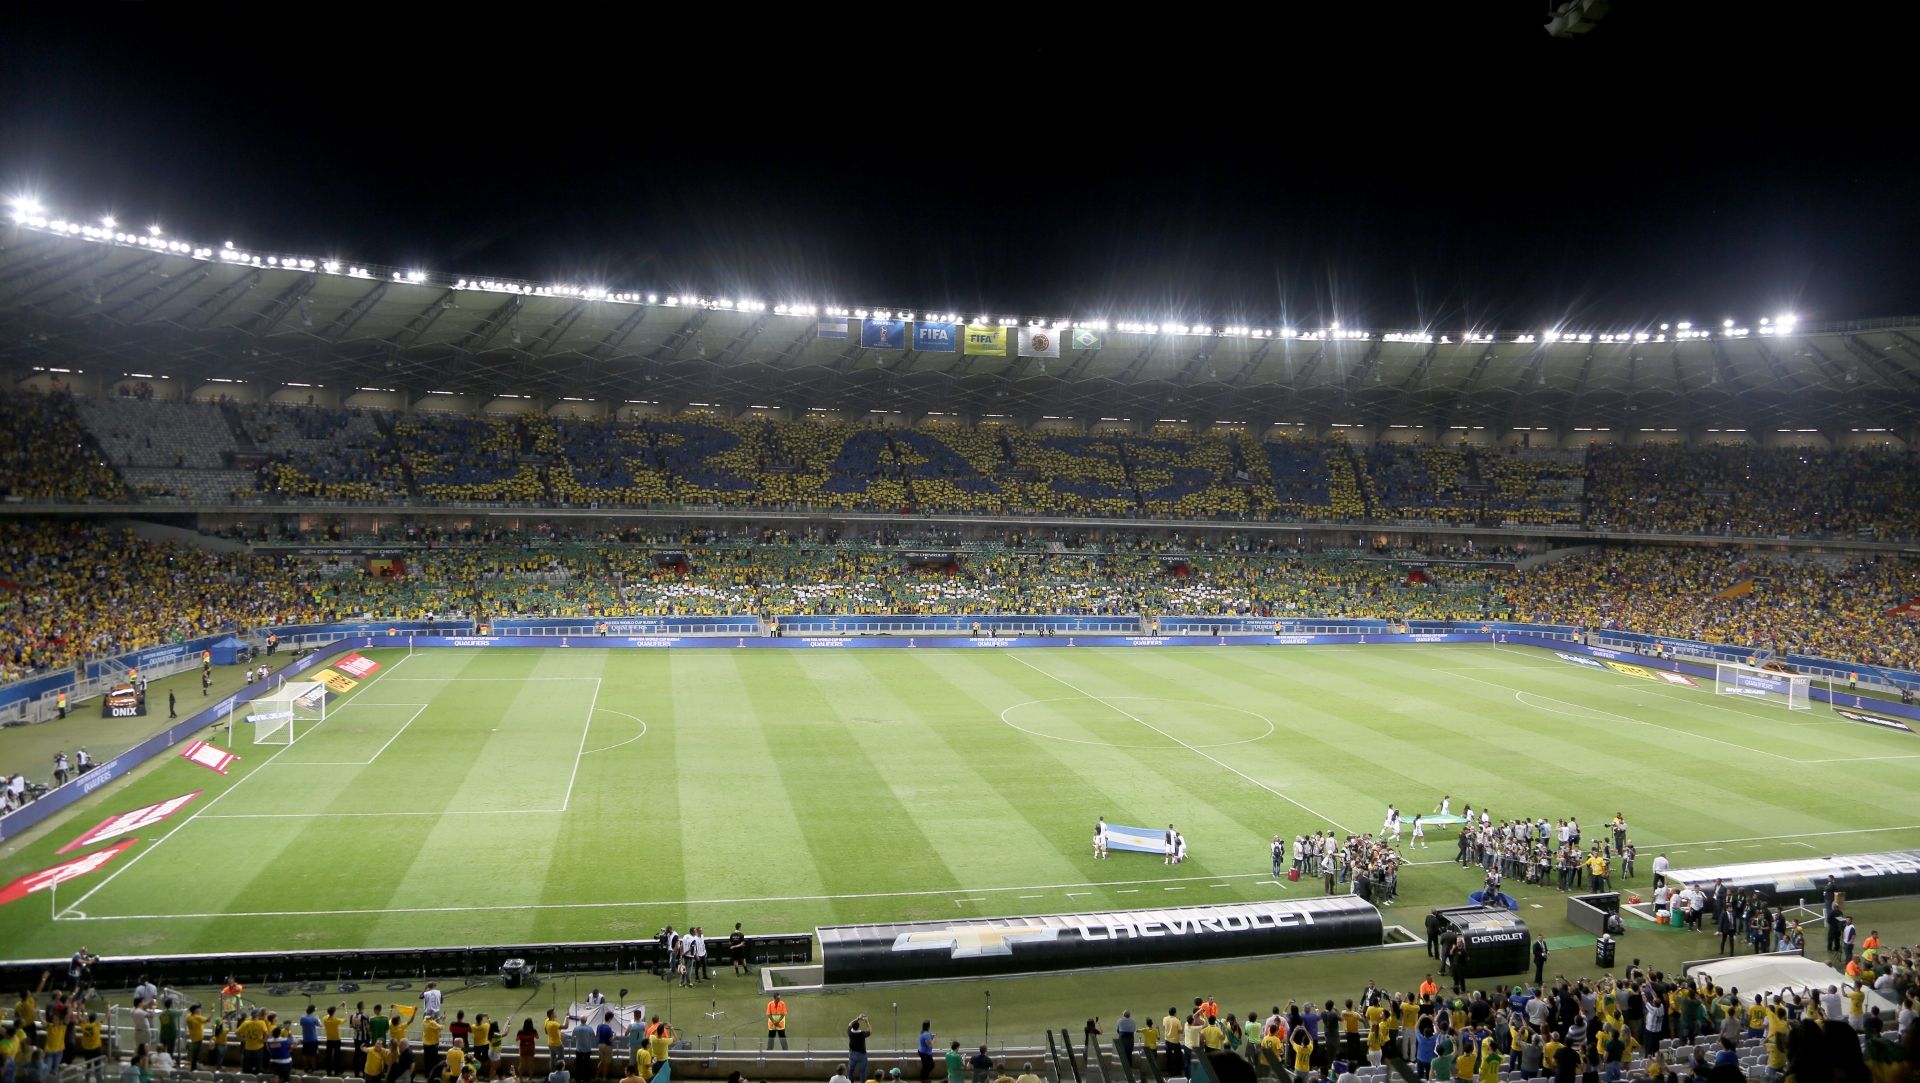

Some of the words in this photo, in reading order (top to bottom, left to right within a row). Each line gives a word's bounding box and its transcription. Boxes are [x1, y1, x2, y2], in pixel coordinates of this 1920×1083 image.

[920, 328, 948, 340] FIFA
[970, 334, 992, 343] FIFA
[112, 707, 137, 717] ONIX
[1077, 909, 1315, 941] CHEVROLET
[1471, 932, 1523, 944] CHEVROLET
